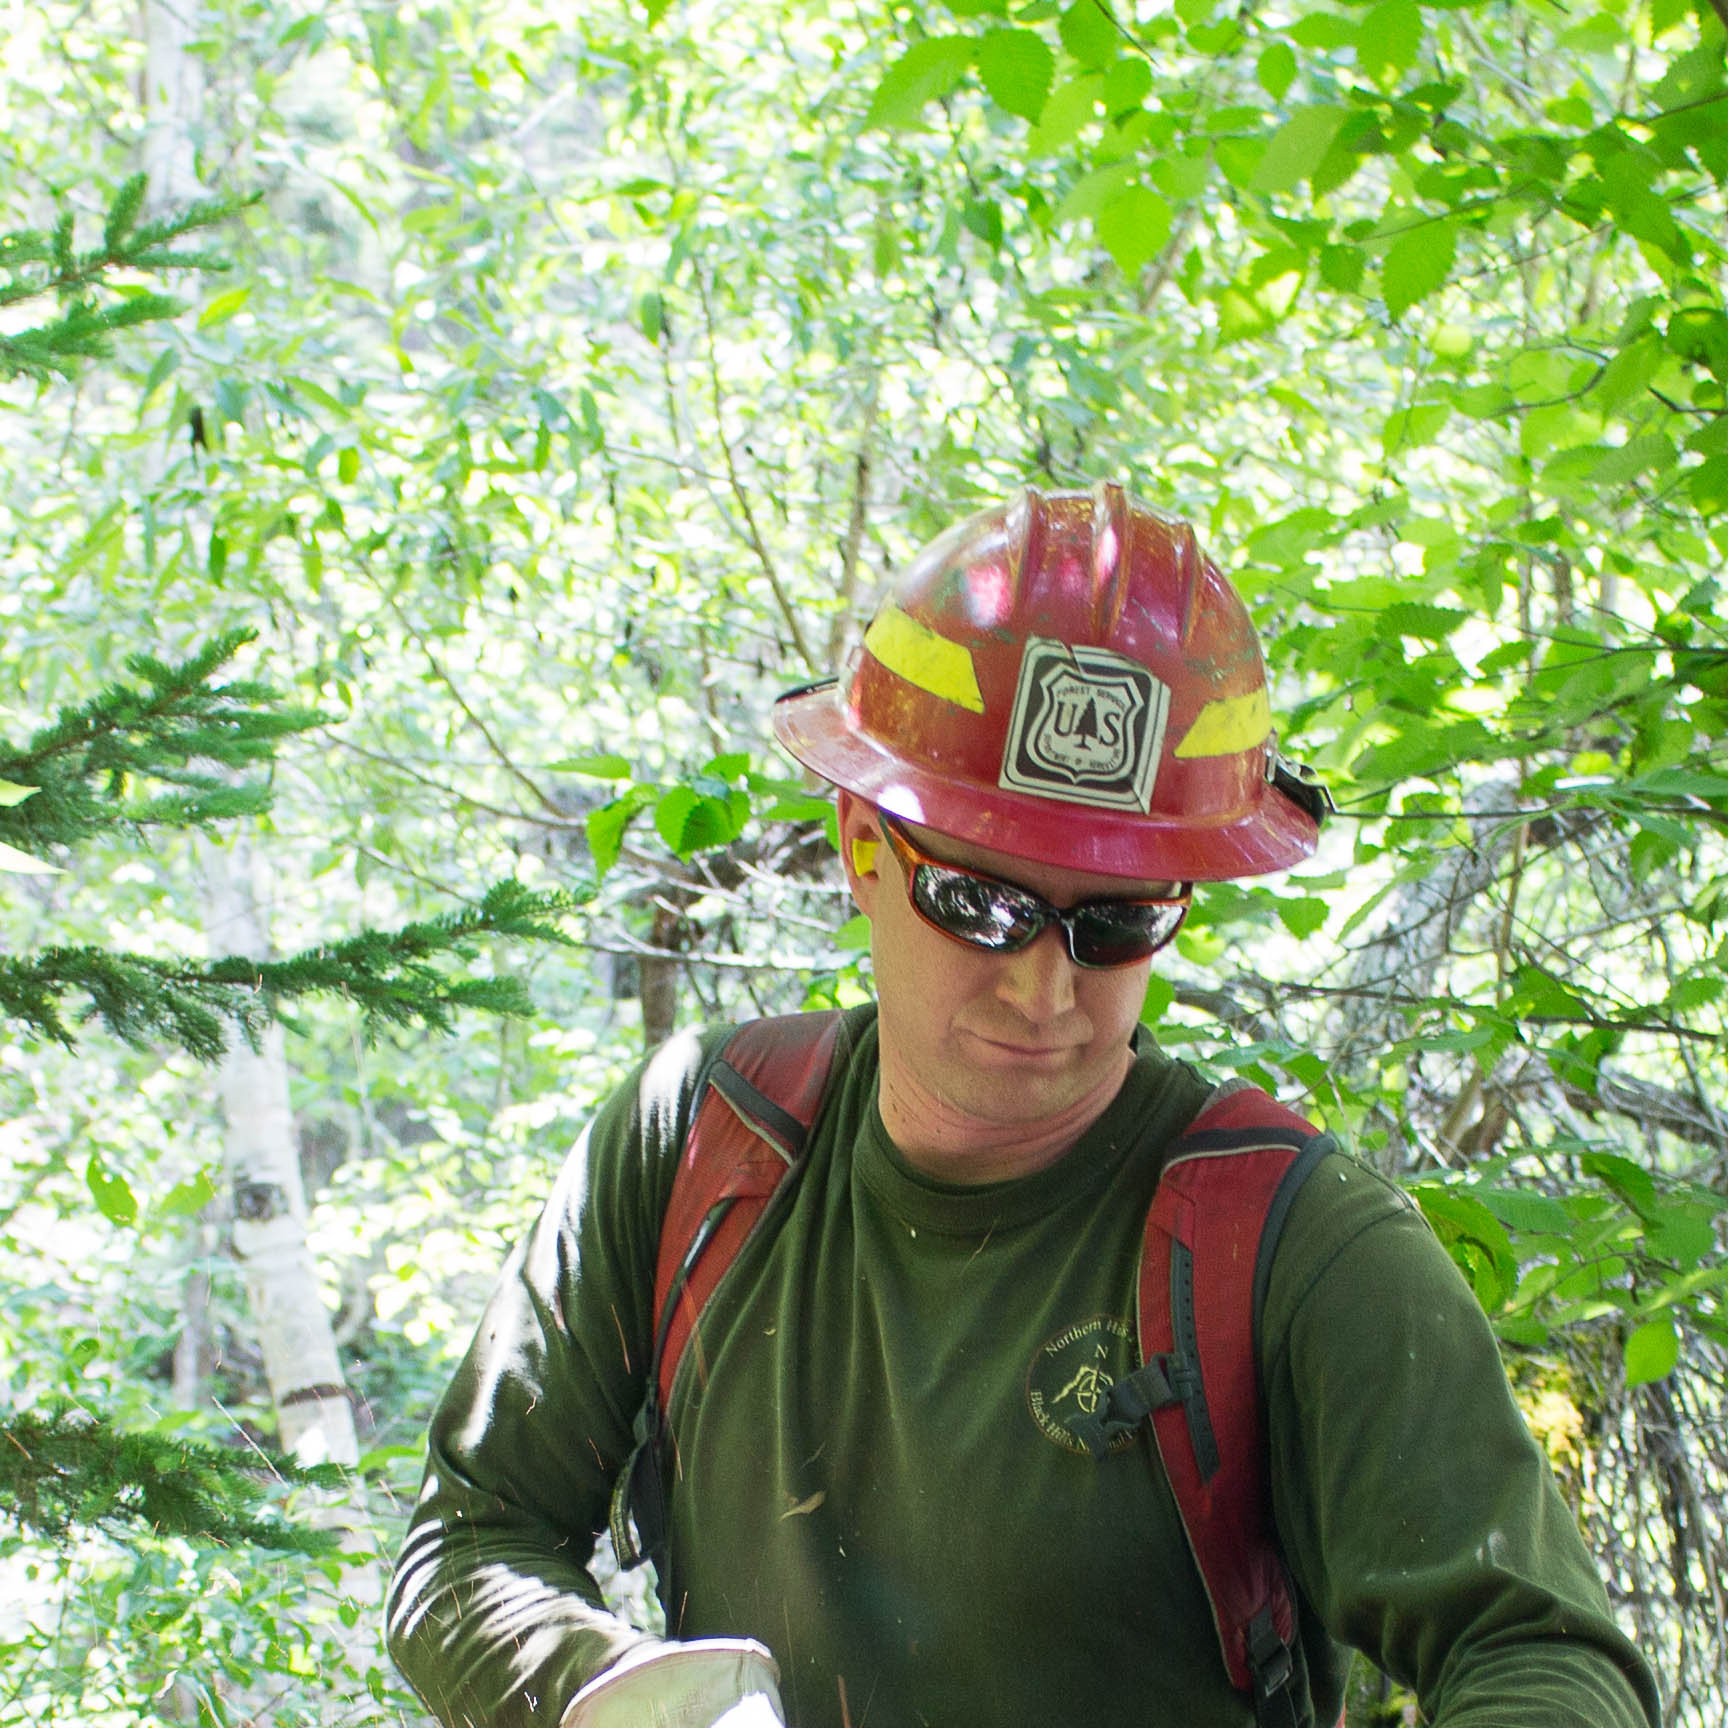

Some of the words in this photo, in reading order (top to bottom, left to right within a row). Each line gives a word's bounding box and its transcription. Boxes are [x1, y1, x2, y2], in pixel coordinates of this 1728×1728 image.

[1045, 1320, 1102, 1358] Northern
[1094, 1343, 1109, 1359] N
[1030, 1391, 1050, 1427] Black
